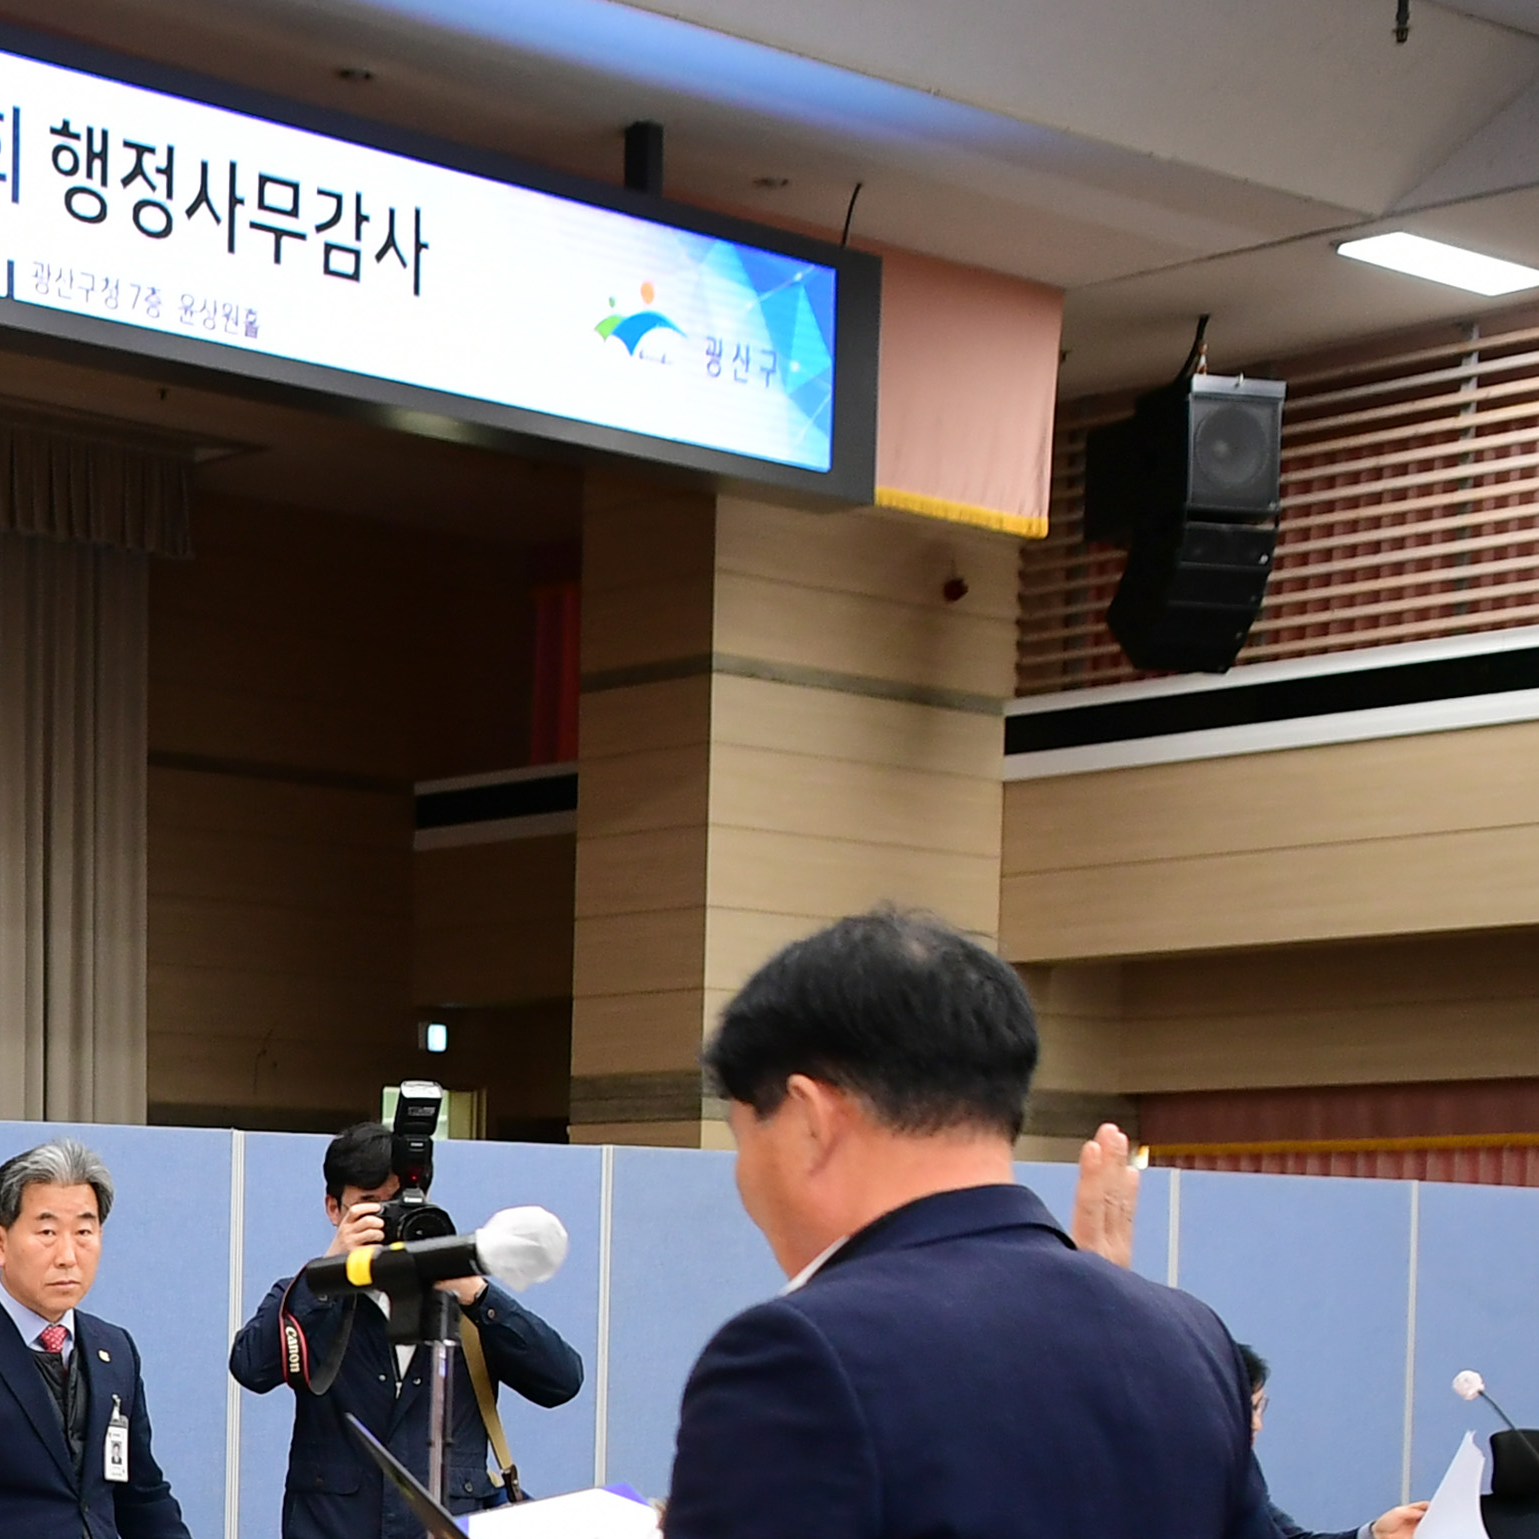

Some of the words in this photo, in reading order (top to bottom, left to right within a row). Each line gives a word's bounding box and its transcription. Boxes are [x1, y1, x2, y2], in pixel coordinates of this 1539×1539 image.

[49, 118, 430, 297] 행정사무감사
[705, 335, 778, 389] 광산구
[285, 1326, 301, 1373] Canon
